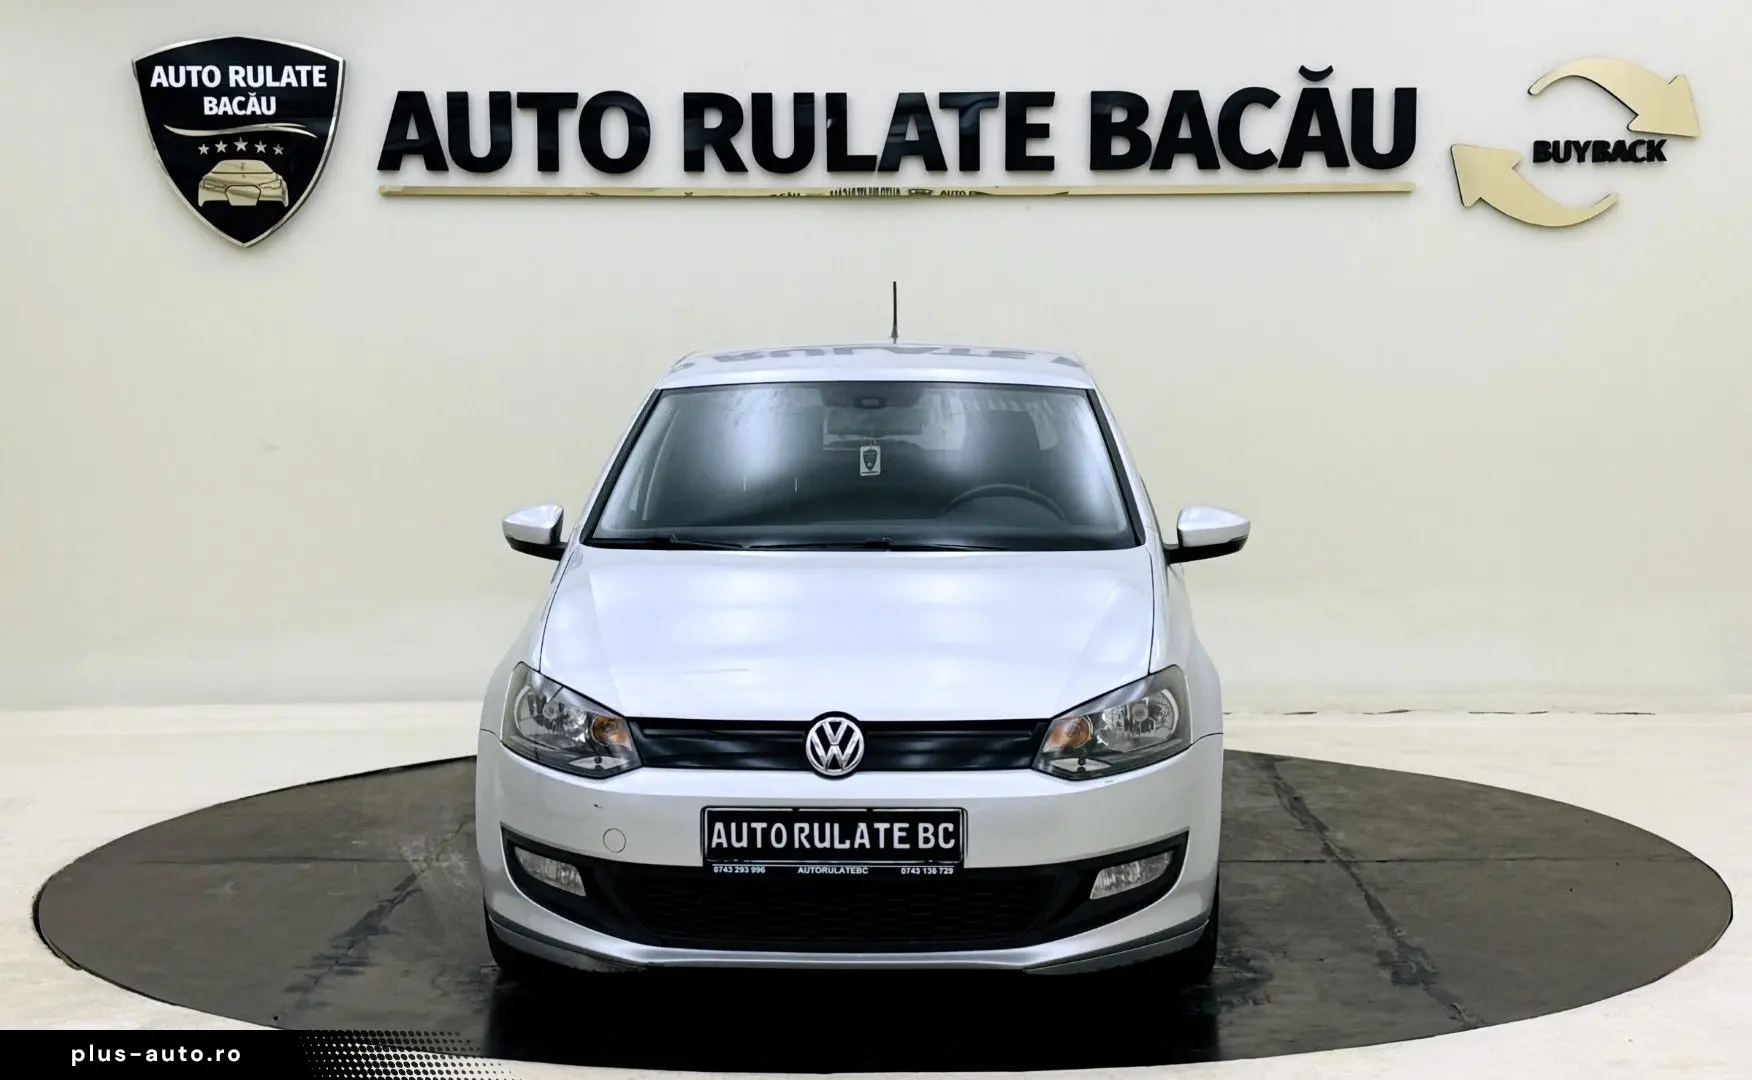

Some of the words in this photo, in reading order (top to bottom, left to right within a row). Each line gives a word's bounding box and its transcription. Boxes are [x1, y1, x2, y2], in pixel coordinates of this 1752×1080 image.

[150, 64, 219, 88] AUTO
[228, 64, 328, 88] RULATE
[203, 91, 277, 116] BACĂU
[377, 90, 651, 175] AUTO
[682, 91, 1056, 175] RULATE
[1089, 65, 1417, 172] BACĂU
[1532, 138, 1668, 164] BUYBACK
[806, 717, 865, 776] VW
[711, 822, 788, 849] AUTO
[793, 822, 910, 849] RULATE
[918, 822, 956, 849] BC
[713, 866, 733, 874] 0743
[797, 866, 869, 875] AUTORULATEBC
[900, 867, 920, 875] 0743
